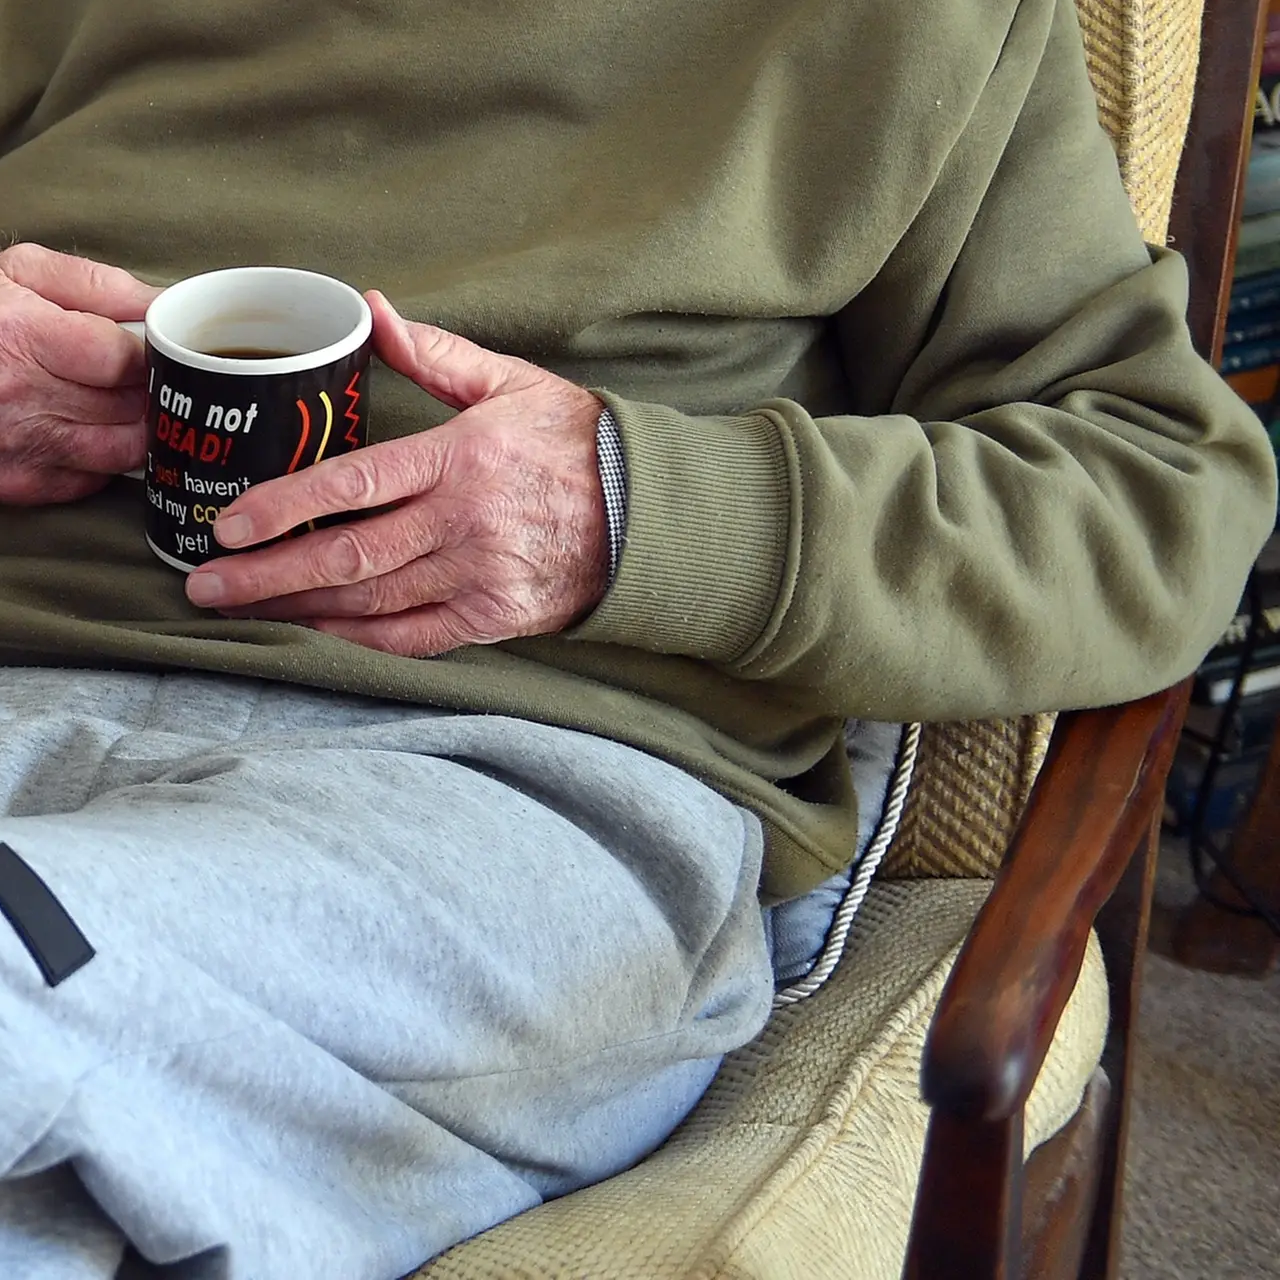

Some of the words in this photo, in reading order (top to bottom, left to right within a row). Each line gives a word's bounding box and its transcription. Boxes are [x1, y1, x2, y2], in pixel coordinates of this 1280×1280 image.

[148, 367, 155, 394] I
[159, 384, 194, 420] am
[205, 402, 259, 434] not
[156, 412, 235, 466] DEAD!
[147, 452, 154, 473] I
[184, 471, 251, 497] haven't
[166, 497, 188, 526] my
[175, 530, 209, 555] yet!
